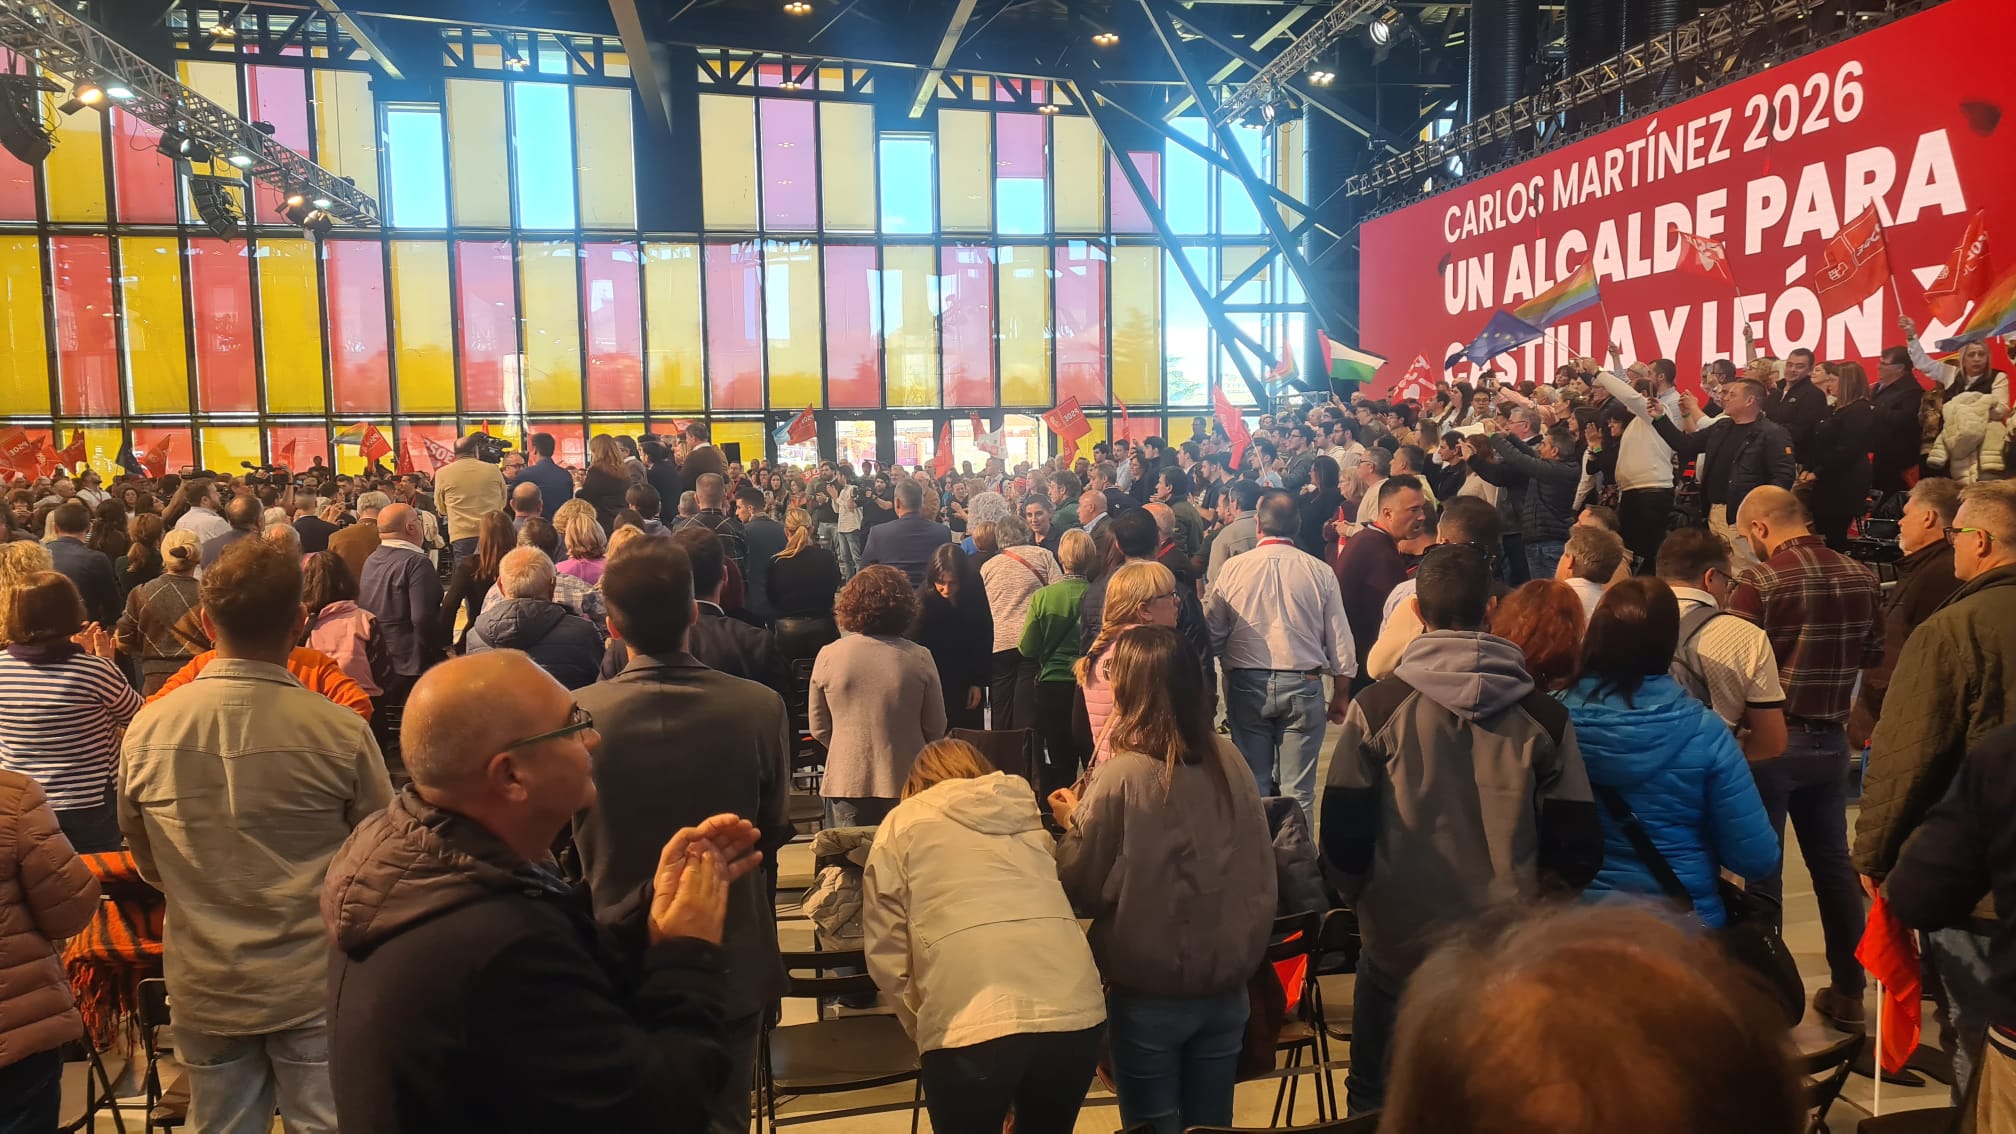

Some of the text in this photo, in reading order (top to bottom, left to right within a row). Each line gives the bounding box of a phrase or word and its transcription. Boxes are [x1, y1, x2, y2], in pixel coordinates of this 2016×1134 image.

[1444, 60, 1865, 244] CARLOS MARTÍNEZ 2026
[1444, 128, 1967, 316] UN ALCALDE PARA
[1649, 304, 1691, 368] Y
[1702, 254, 1884, 368] LEÓN
